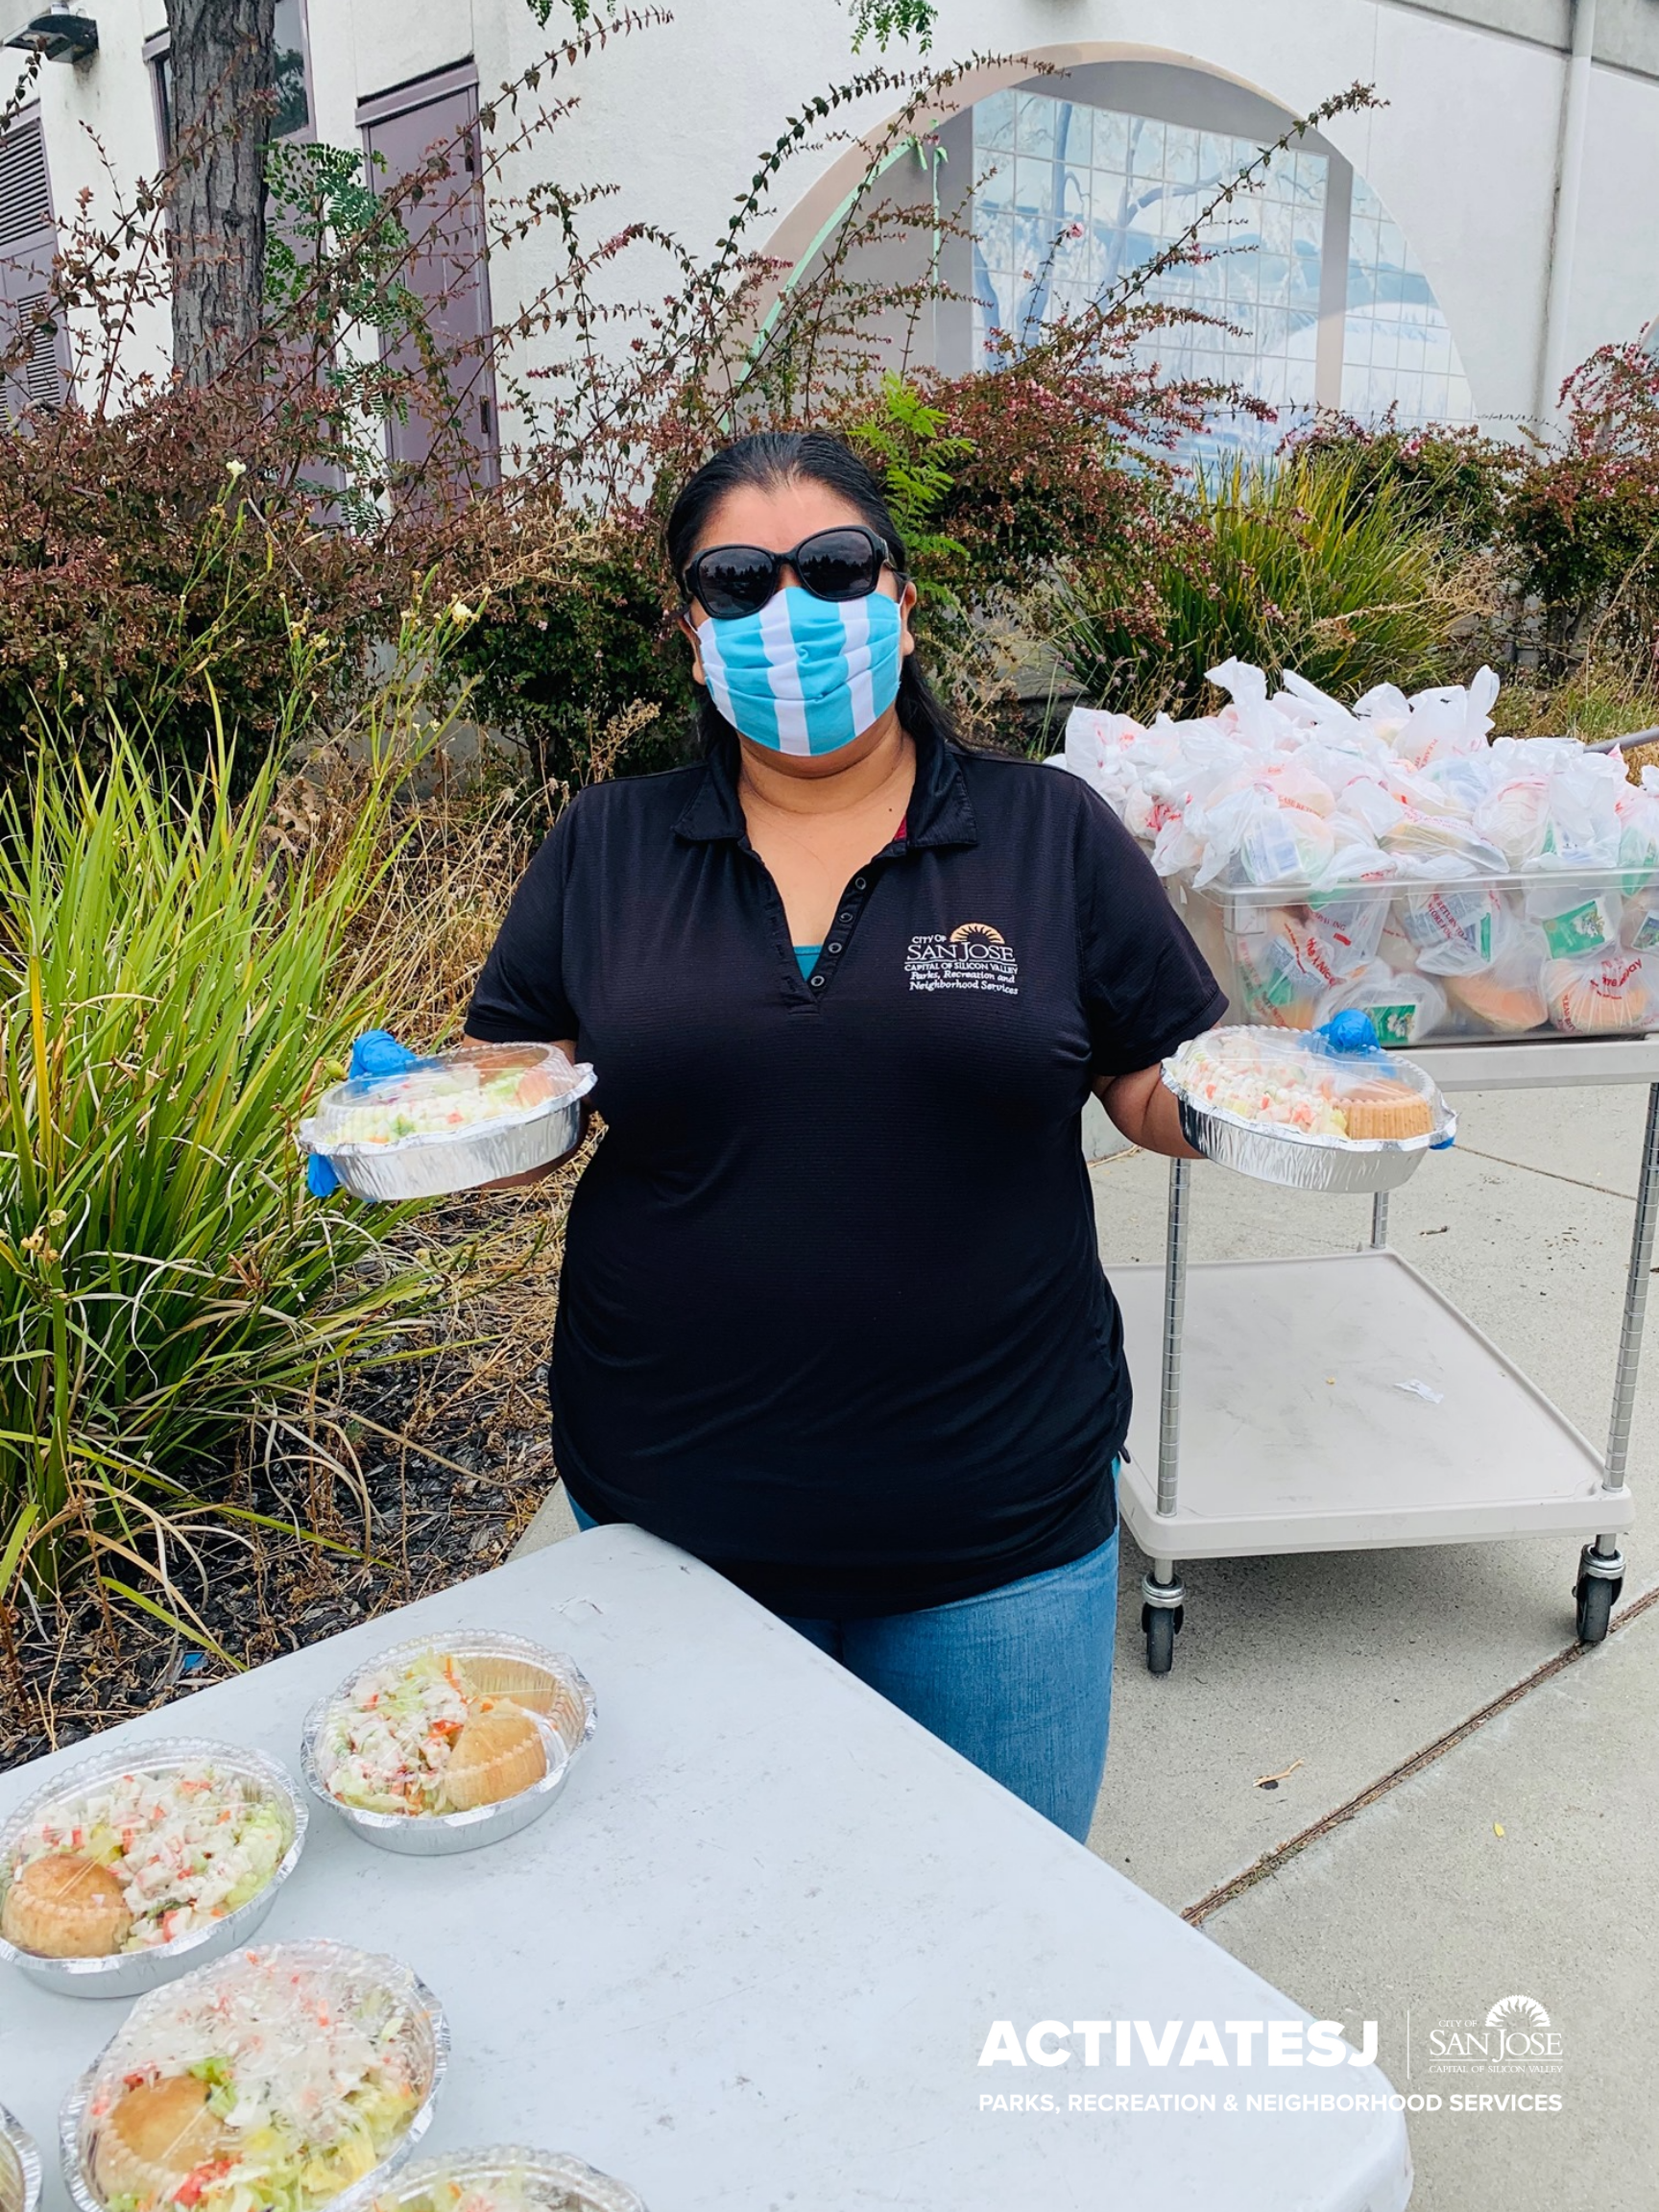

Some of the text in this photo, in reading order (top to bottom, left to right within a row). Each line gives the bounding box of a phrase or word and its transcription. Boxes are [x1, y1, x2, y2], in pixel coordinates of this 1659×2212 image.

[911, 934, 947, 944] CITY OF
[906, 942, 1016, 964] SAN JOSE
[904, 963, 940, 972] CAPITAL
[954, 962, 989, 971] SILICON
[990, 963, 1019, 974] VALLEY
[909, 970, 1016, 984] Parks, Recreation and
[909, 978, 1020, 996] Neighborhood Services
